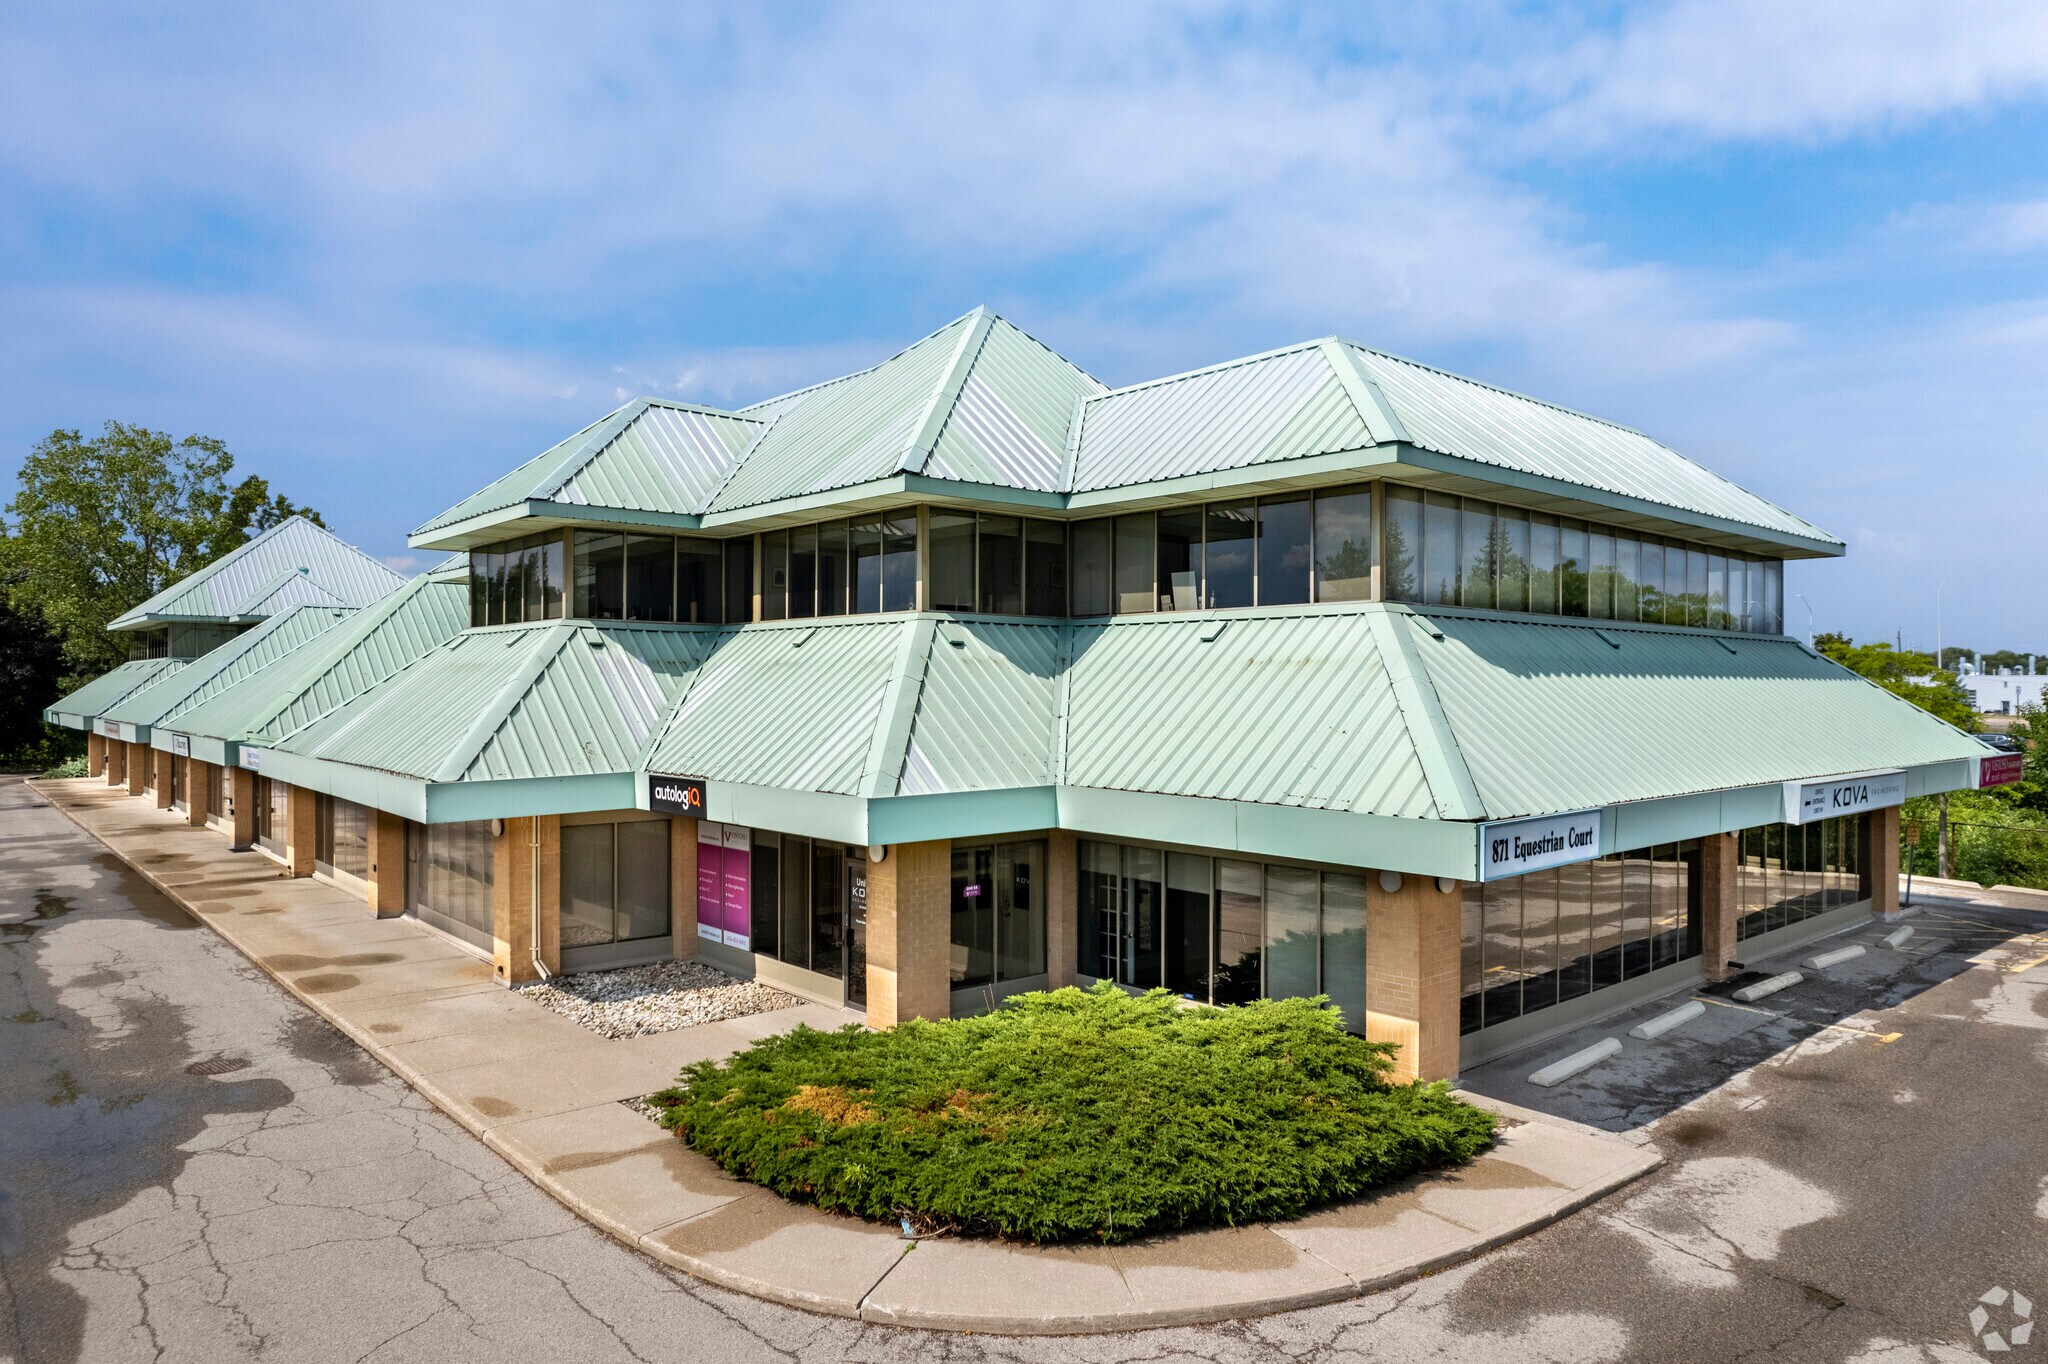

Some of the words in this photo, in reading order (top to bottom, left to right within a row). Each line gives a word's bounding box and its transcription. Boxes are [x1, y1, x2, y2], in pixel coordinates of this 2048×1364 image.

[655, 784, 701, 810] autologiQ
[1833, 785, 1868, 808] KOVA
[1871, 785, 1900, 796] ENGINEERING
[1492, 838, 1509, 863] 871
[1514, 830, 1564, 862] Equestrian
[1568, 827, 1593, 848] Court
[852, 886, 866, 897] KO
[1016, 876, 1030, 884] KOV
